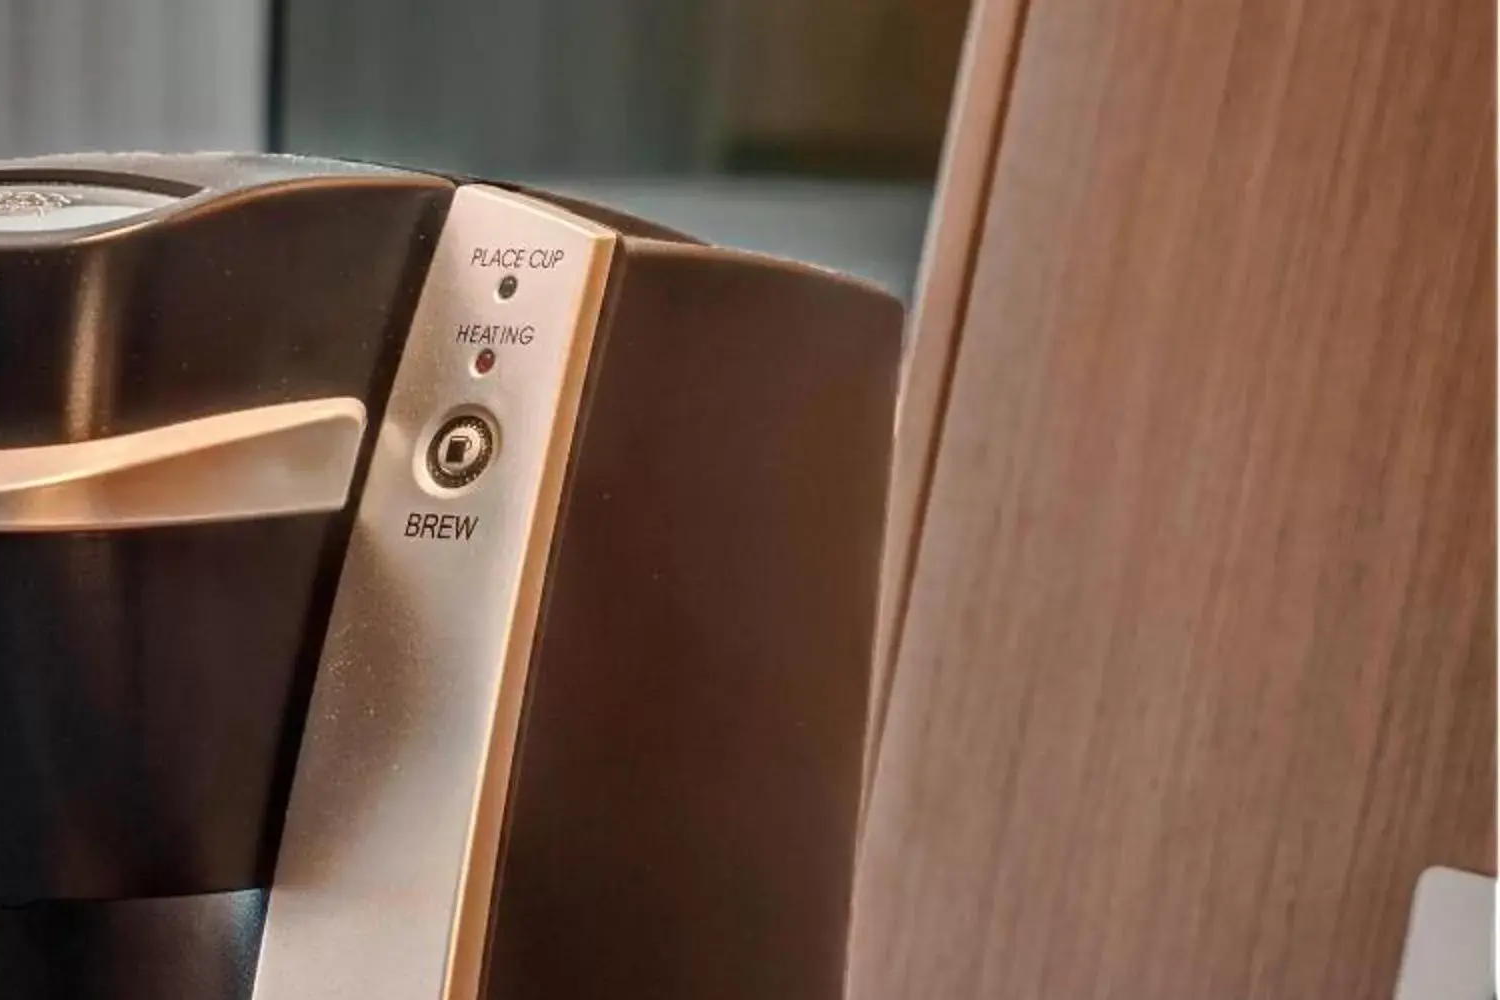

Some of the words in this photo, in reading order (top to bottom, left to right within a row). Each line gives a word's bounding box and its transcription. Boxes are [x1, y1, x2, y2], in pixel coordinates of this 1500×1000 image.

[470, 249, 524, 268] PLACE
[529, 249, 564, 269] CUP
[456, 324, 536, 346] HEATING
[404, 513, 479, 541] BREW
